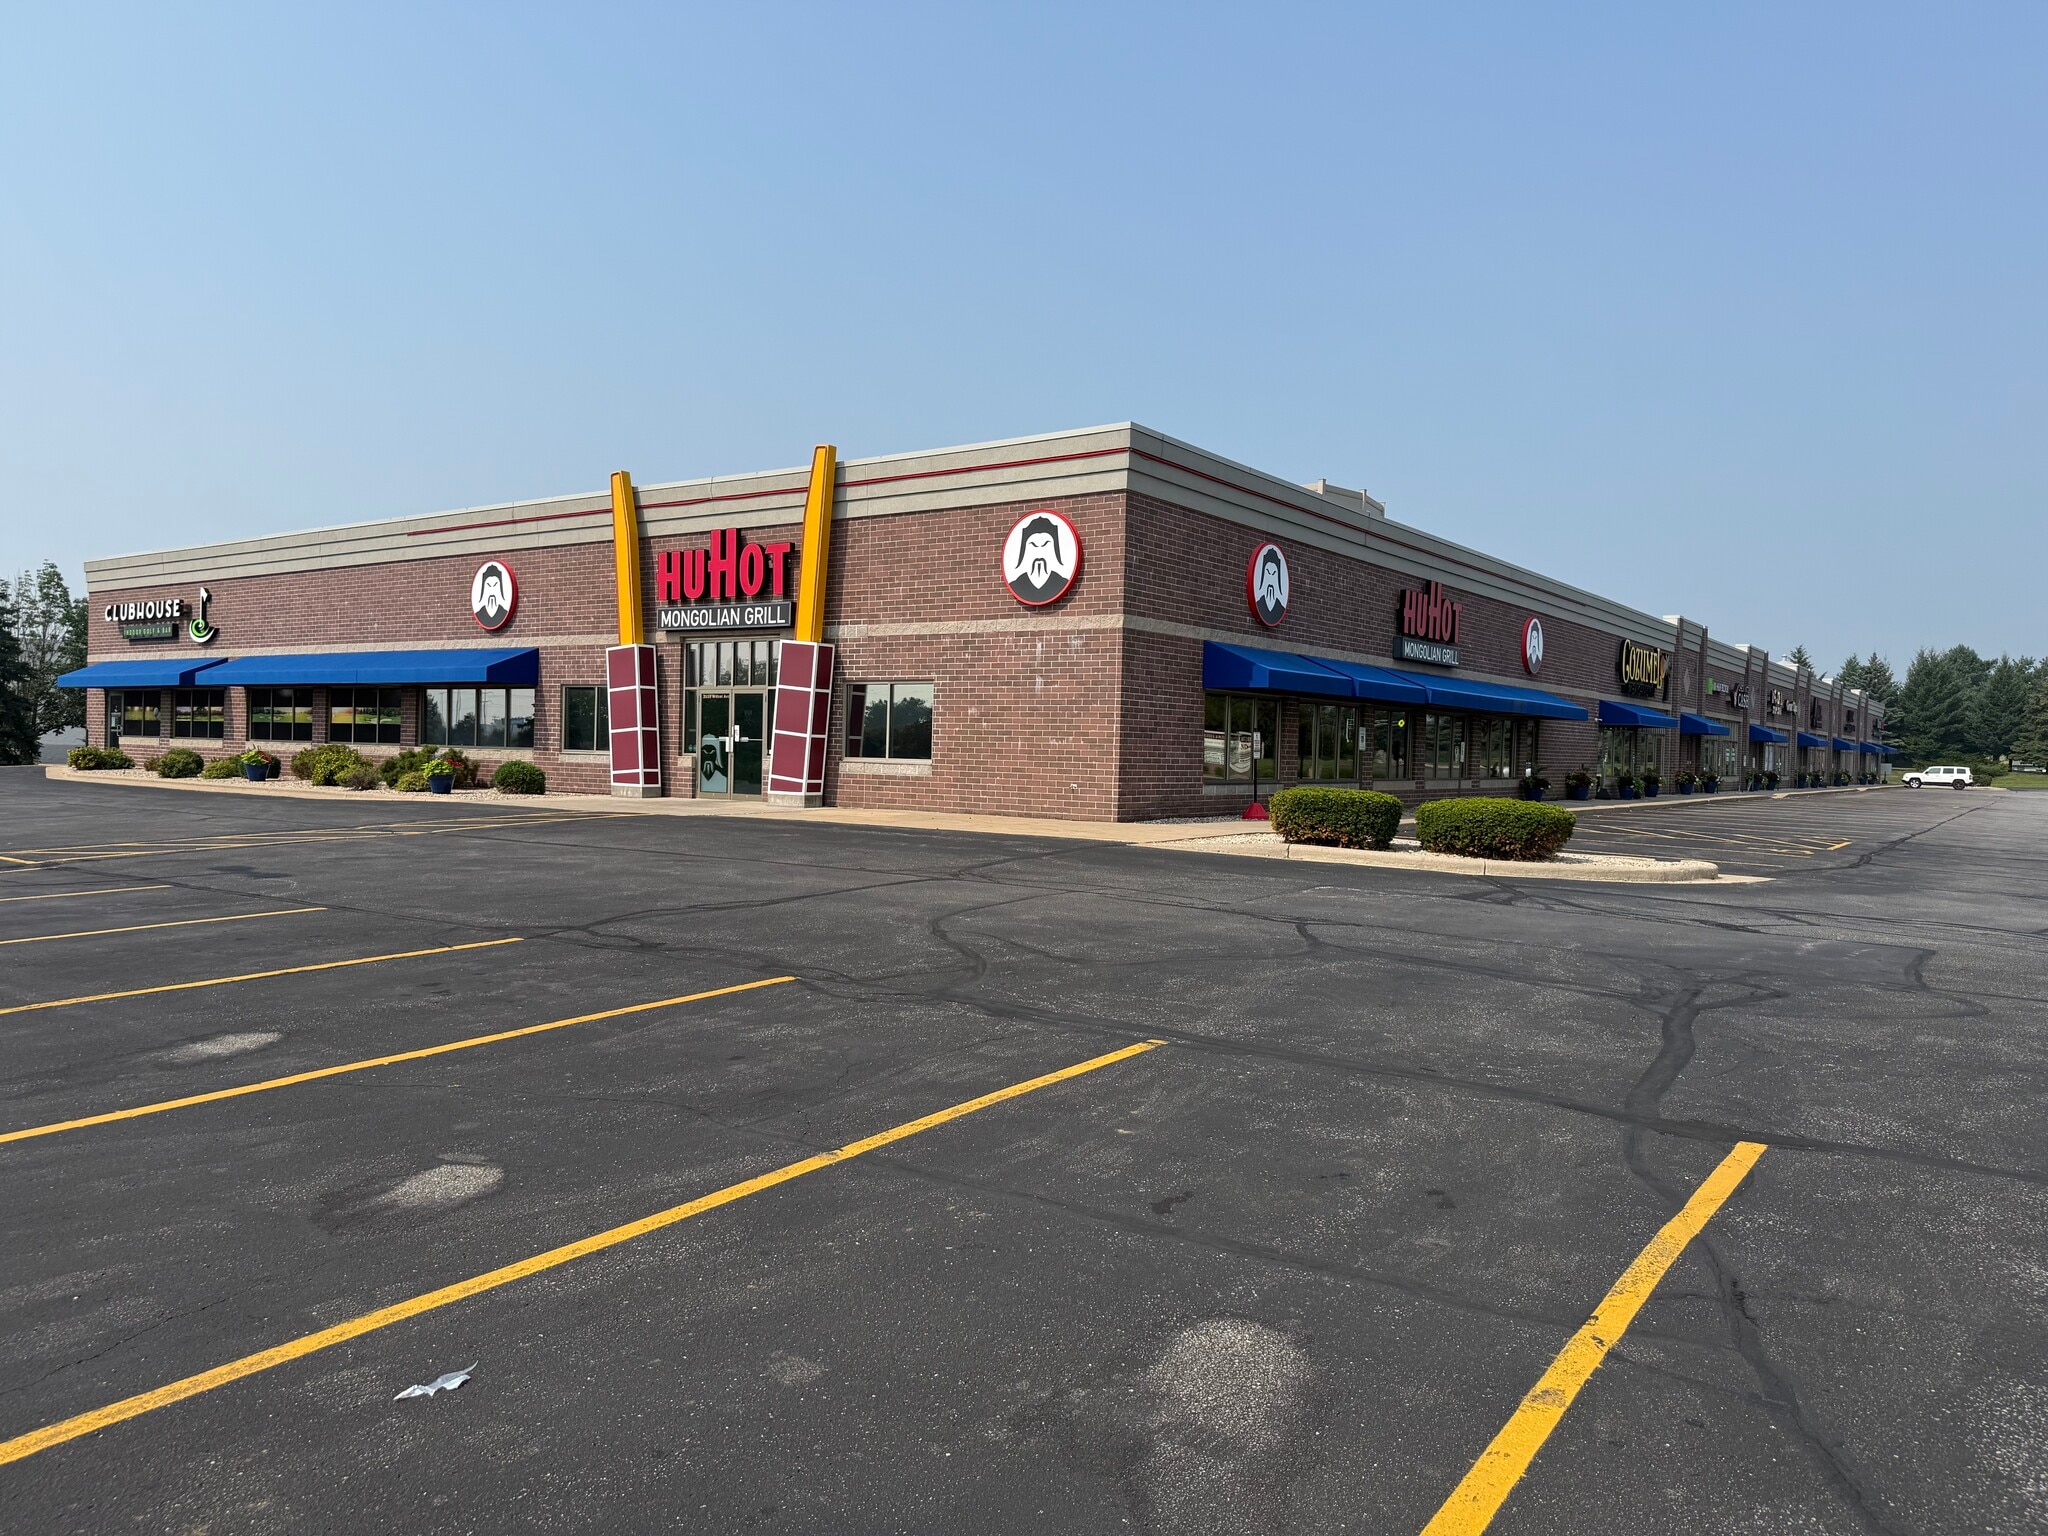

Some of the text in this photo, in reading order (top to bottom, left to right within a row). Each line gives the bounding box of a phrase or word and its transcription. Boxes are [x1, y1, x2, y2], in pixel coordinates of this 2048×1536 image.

[105, 599, 180, 621] CLUBHOUSE
[661, 605, 786, 627] MONGOLIAN GRILL
[1404, 641, 1459, 665] MONGOLIAN GRILL
